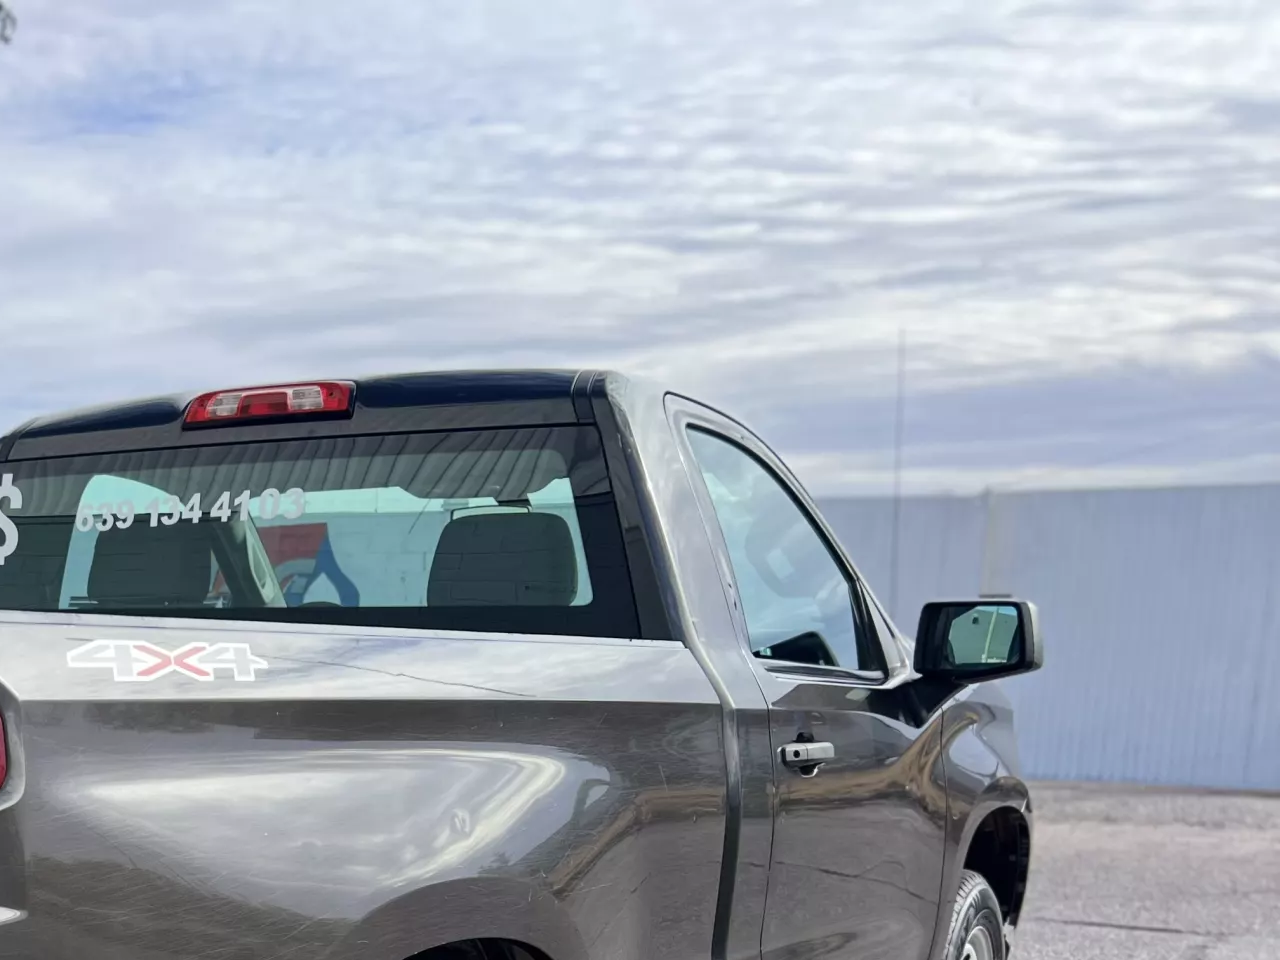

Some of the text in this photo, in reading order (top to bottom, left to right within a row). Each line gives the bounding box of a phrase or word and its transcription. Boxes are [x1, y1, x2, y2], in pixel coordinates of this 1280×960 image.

[75, 487, 306, 533] 639 134 4103
